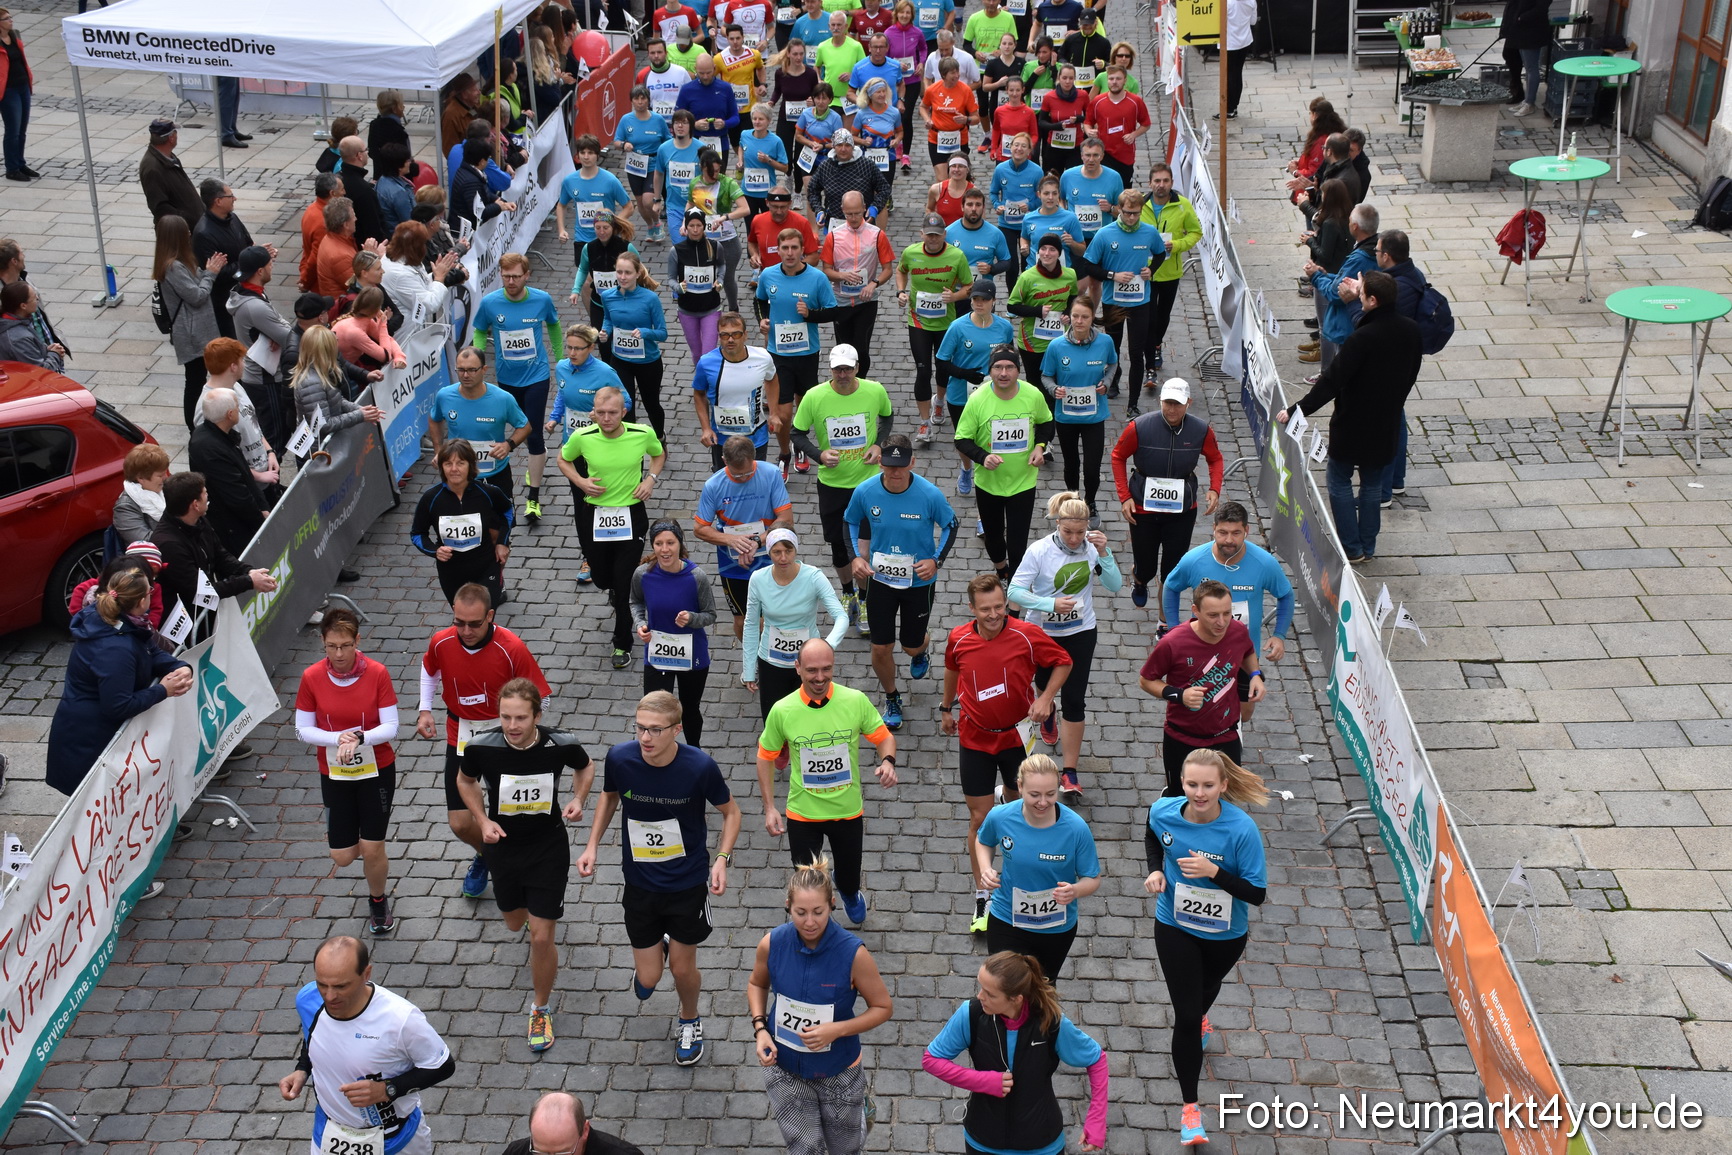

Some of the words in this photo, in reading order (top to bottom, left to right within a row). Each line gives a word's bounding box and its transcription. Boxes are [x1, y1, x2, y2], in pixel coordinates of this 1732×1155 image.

[1192, 3, 1214, 15] lauf
[82, 28, 130, 45] BMW
[136, 32, 275, 55] ConnectedDrive
[85, 47, 141, 63] Vernetzt,
[144, 52, 162, 62] um
[164, 53, 184, 64] frei
[188, 56, 201, 65] zu
[204, 56, 233, 67] sein.
[727, 64, 741, 72] MAX
[628, 158, 644, 168] 2405
[672, 169, 691, 177] 2407
[1078, 213, 1098, 222] 2309
[688, 274, 709, 283] 2106
[1118, 283, 1140, 292] 2233
[920, 300, 942, 308] 2765
[1039, 319, 1061, 329] 2128
[506, 338, 530, 349] 2486
[617, 337, 639, 347] 2550
[780, 332, 804, 342] 2572
[1067, 395, 1091, 405] 2138
[720, 415, 745, 426] 2515
[833, 425, 861, 438] 2483
[997, 429, 1024, 441] 2140
[1150, 487, 1178, 501] 2600
[598, 516, 626, 528] 2035
[445, 526, 476, 539] 2148
[878, 564, 907, 577] 2333
[1047, 612, 1078, 622] 2126
[170, 615, 186, 637] swn
[654, 643, 686, 657] 2904
[774, 638, 803, 652] 2258
[1208, 662, 1233, 686] YOUR
[231, 710, 254, 736] GmbH
[808, 757, 843, 774] 2528
[512, 788, 540, 802] 413
[632, 794, 654, 803] GOSSEN
[646, 833, 664, 847] 32
[1020, 899, 1058, 915] 2142
[1182, 900, 1223, 918] 2242
[32, 974, 95, 1062] Service-Line:
[1485, 988, 1515, 1037] Neumarkts
[330, 1137, 374, 1155] 2238
